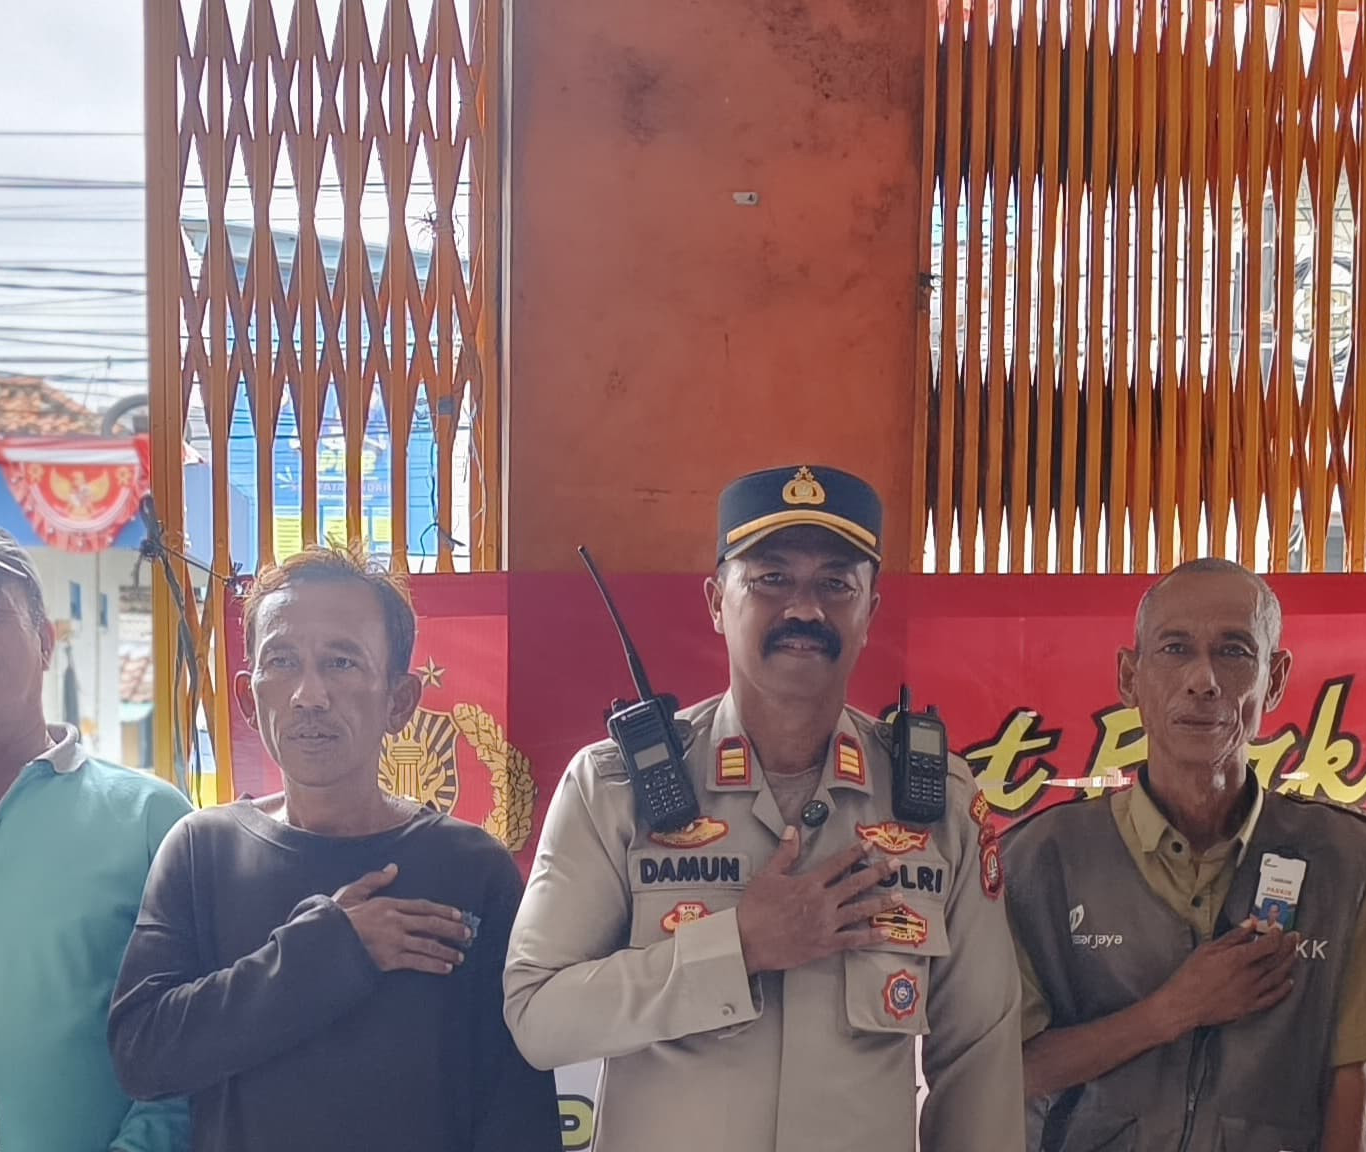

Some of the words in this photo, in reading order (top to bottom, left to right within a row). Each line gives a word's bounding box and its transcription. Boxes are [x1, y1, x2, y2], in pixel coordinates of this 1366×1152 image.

[639, 856, 740, 884] DAMUN
[1091, 932, 1123, 950] jaya
[1294, 938, 1330, 960] KK
